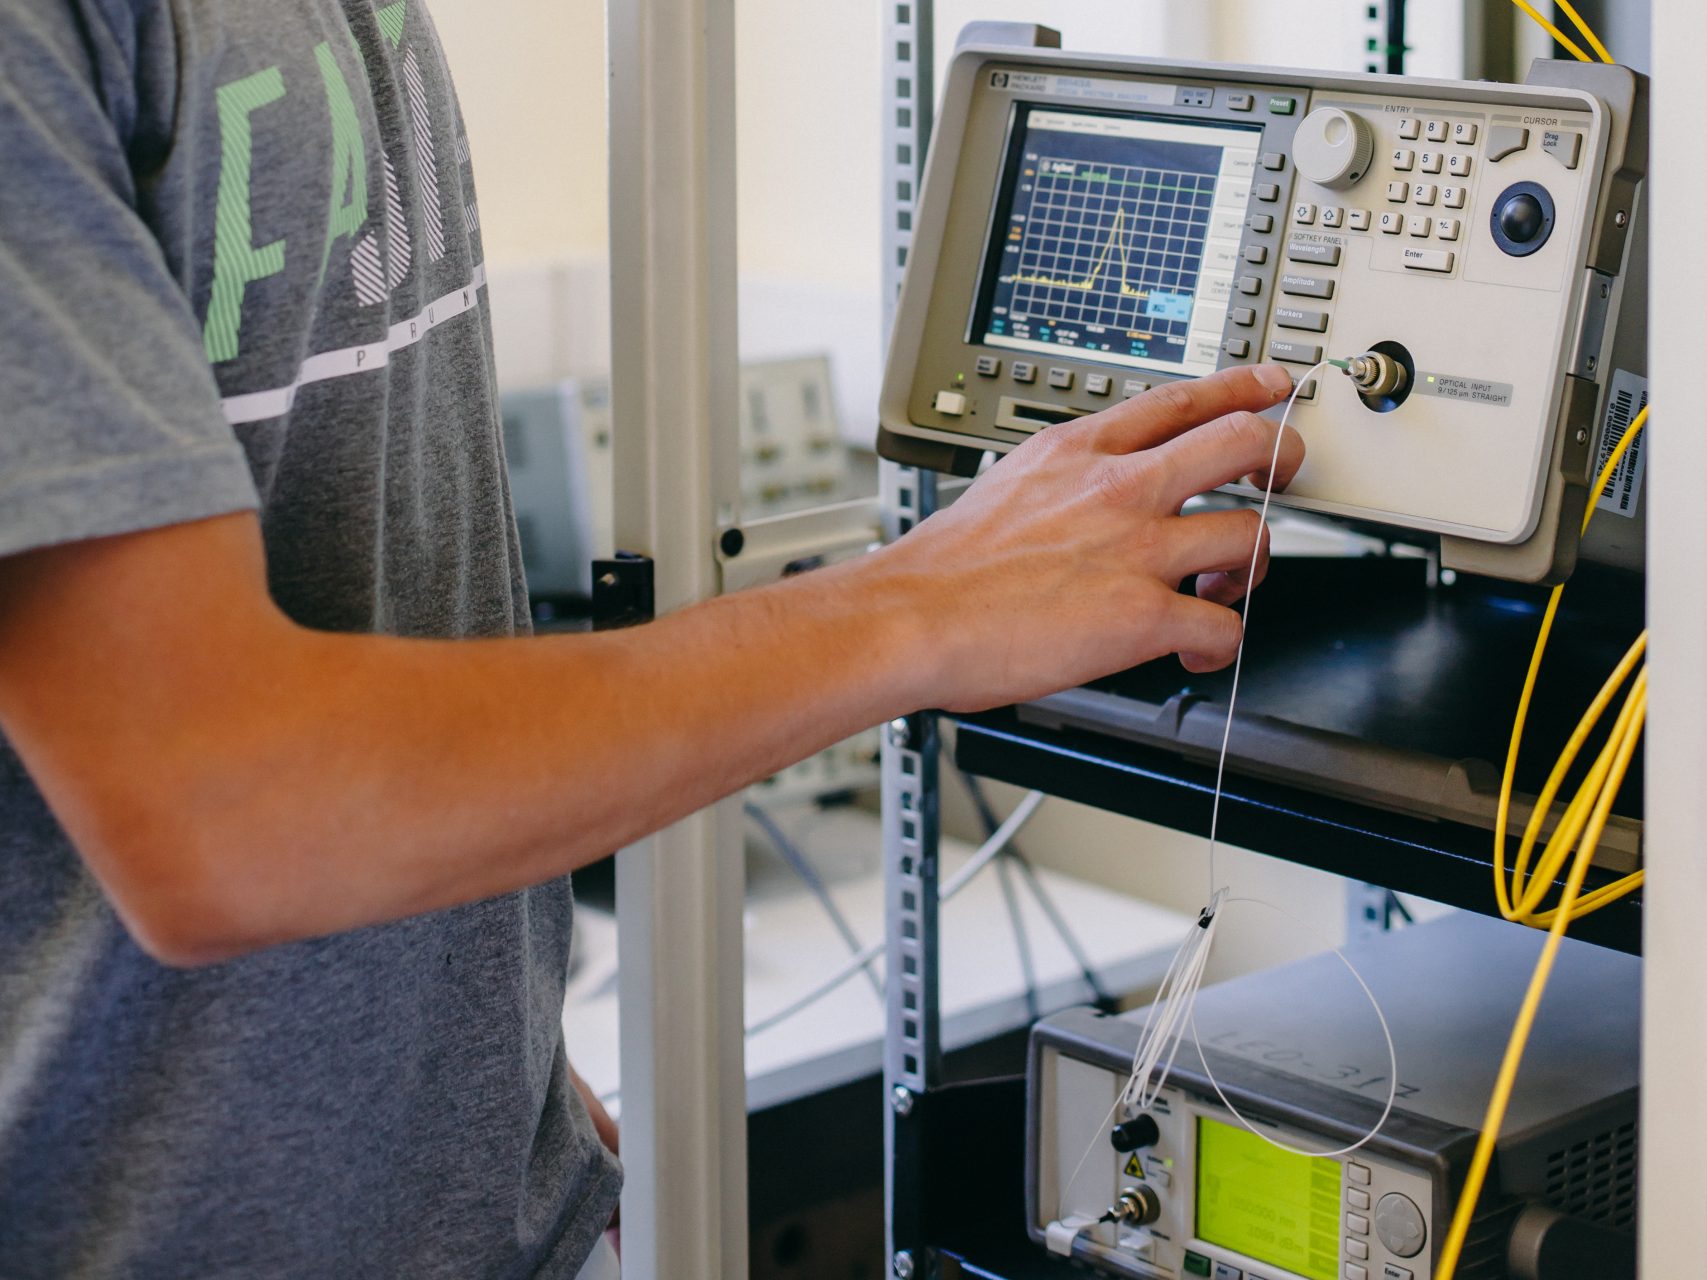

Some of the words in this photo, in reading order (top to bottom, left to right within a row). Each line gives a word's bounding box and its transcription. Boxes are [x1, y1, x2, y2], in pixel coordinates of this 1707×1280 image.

[1270, 98, 1289, 107] Preset
[1385, 105, 1411, 113] ENTRY
[1400, 120, 1406, 129] 7
[1523, 116, 1558, 126] CURSOR
[1428, 122, 1435, 131] 8
[1456, 125, 1463, 134] 9
[1544, 132, 1559, 141] Drag
[1394, 151, 1401, 160] 4
[1422, 154, 1428, 163] 5
[1450, 156, 1457, 166] 6
[1416, 186, 1423, 196] 2
[1444, 188, 1451, 198] 3
[1382, 215, 1389, 224] 0
[1294, 233, 1322, 242] SOFTKEY
[1323, 236, 1342, 245] PANEL
[1289, 243, 1326, 254] Wavelength
[1404, 249, 1423, 259] Enter
[1283, 276, 1315, 286] Amplitude
[1276, 308, 1303, 318] Markers
[1271, 341, 1293, 351] Traces
[1439, 378, 1468, 389] OPTICAL
[1471, 383, 1492, 392] INPUT
[1472, 391, 1507, 402] STRAIGHT
